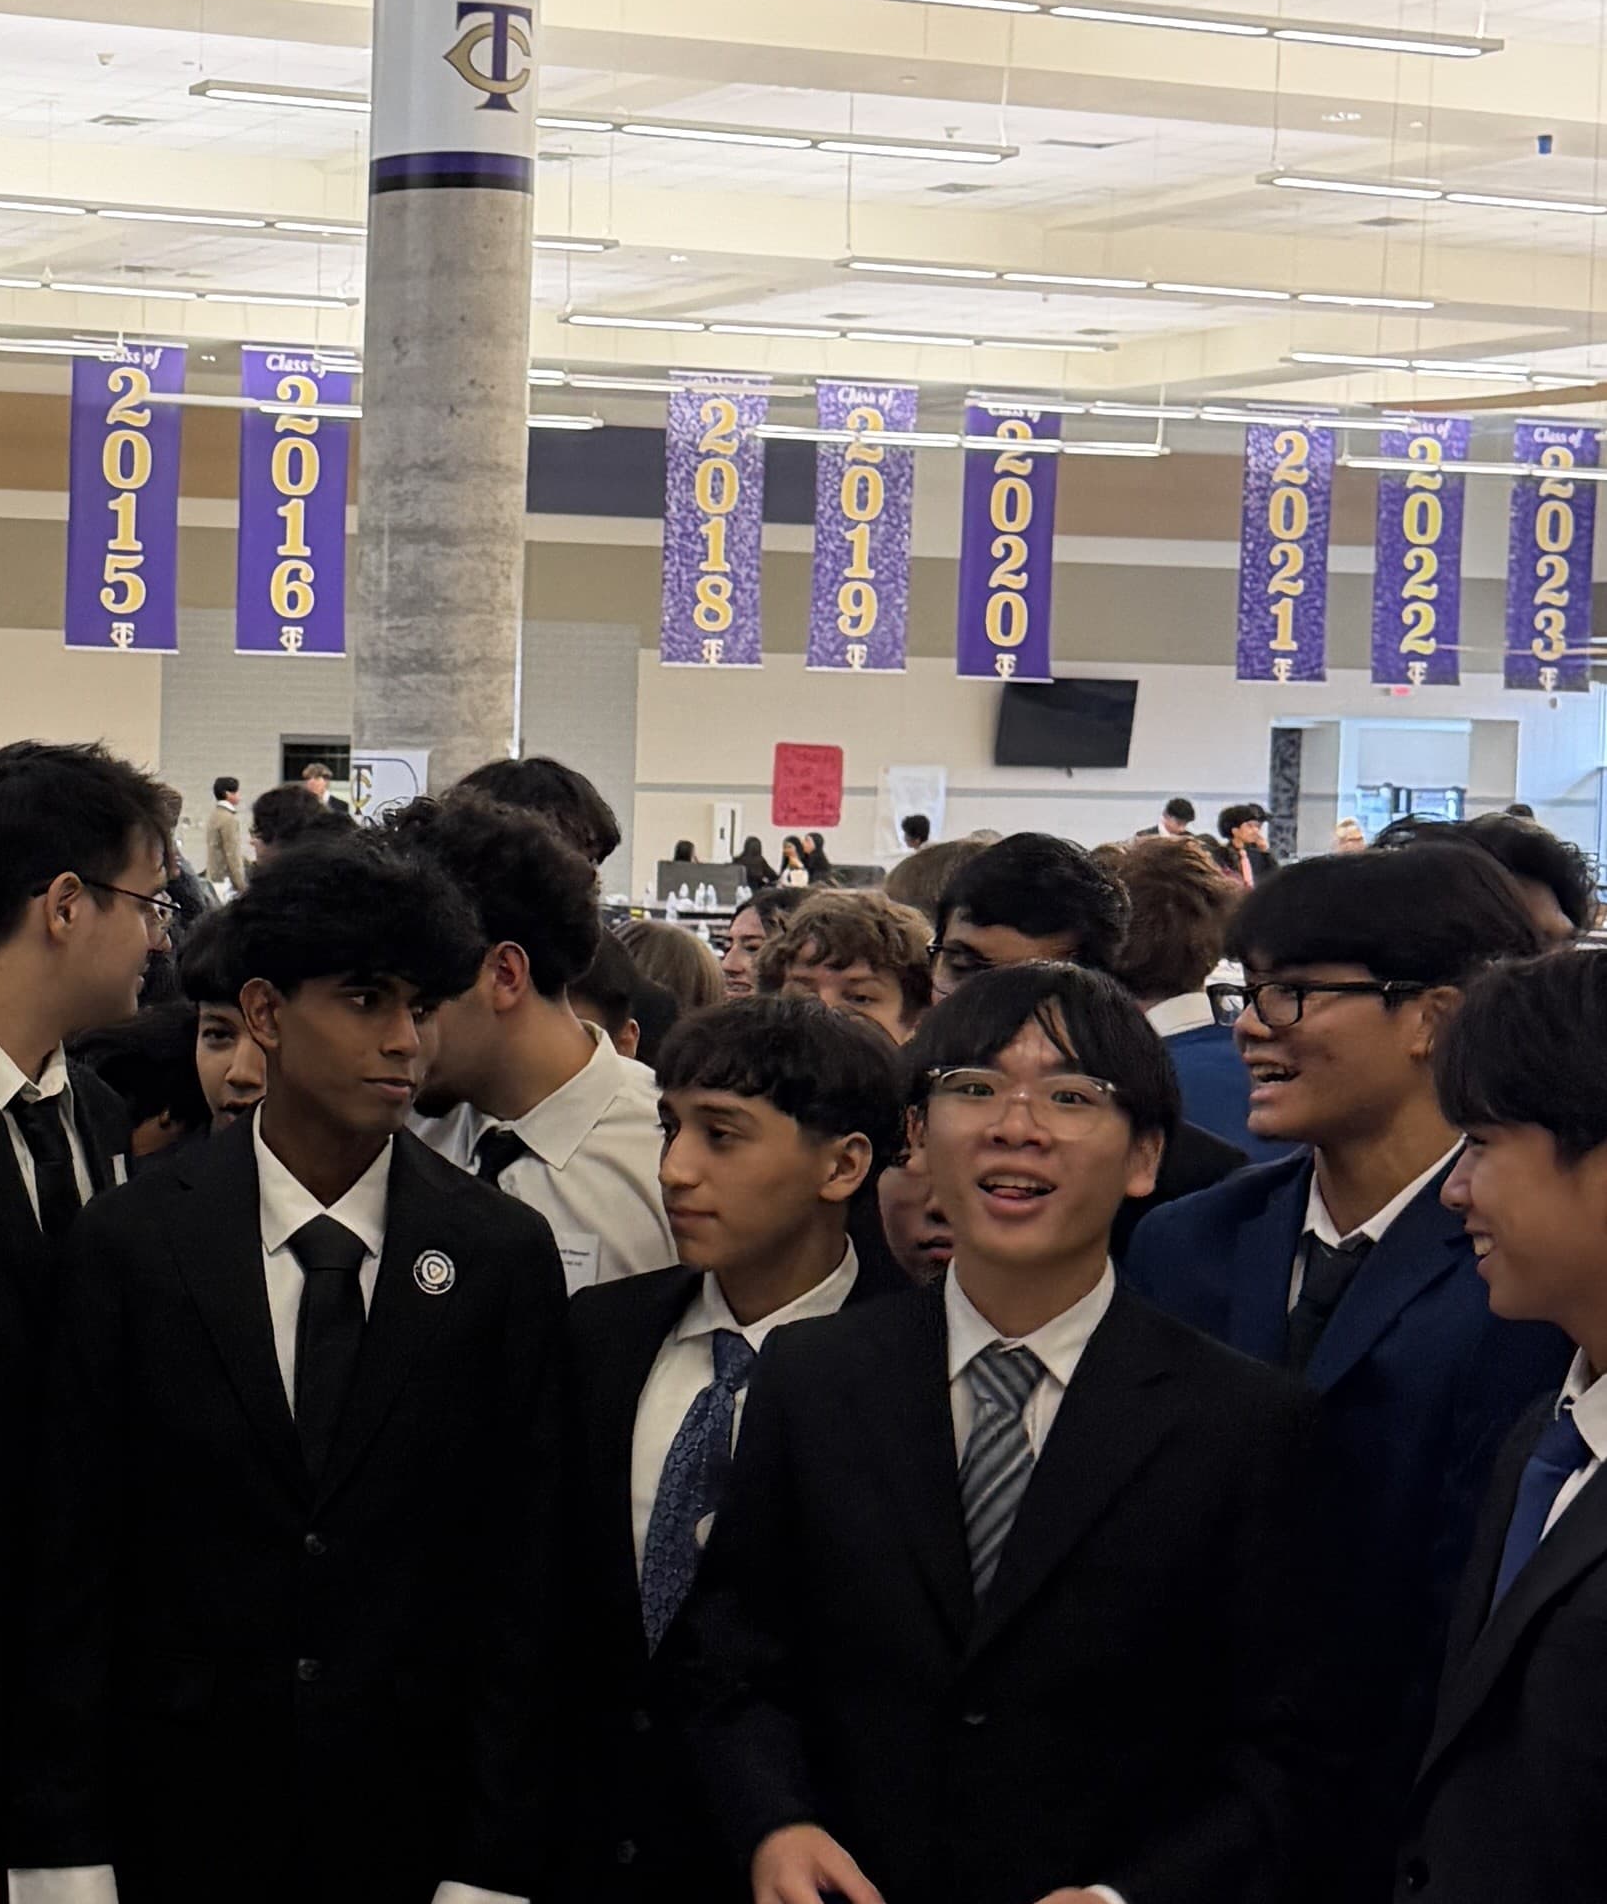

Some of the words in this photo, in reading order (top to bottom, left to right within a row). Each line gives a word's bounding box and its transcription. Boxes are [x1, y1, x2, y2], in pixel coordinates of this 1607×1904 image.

[266, 353, 308, 373] Class
[100, 366, 152, 615] 2015
[270, 374, 320, 619] 2016
[693, 399, 740, 633] 2018
[837, 407, 885, 638] 2019
[985, 419, 1034, 648] 2020
[1267, 430, 1310, 652] 2021
[1399, 436, 1443, 656] 2022
[1531, 446, 1575, 662] 2023
